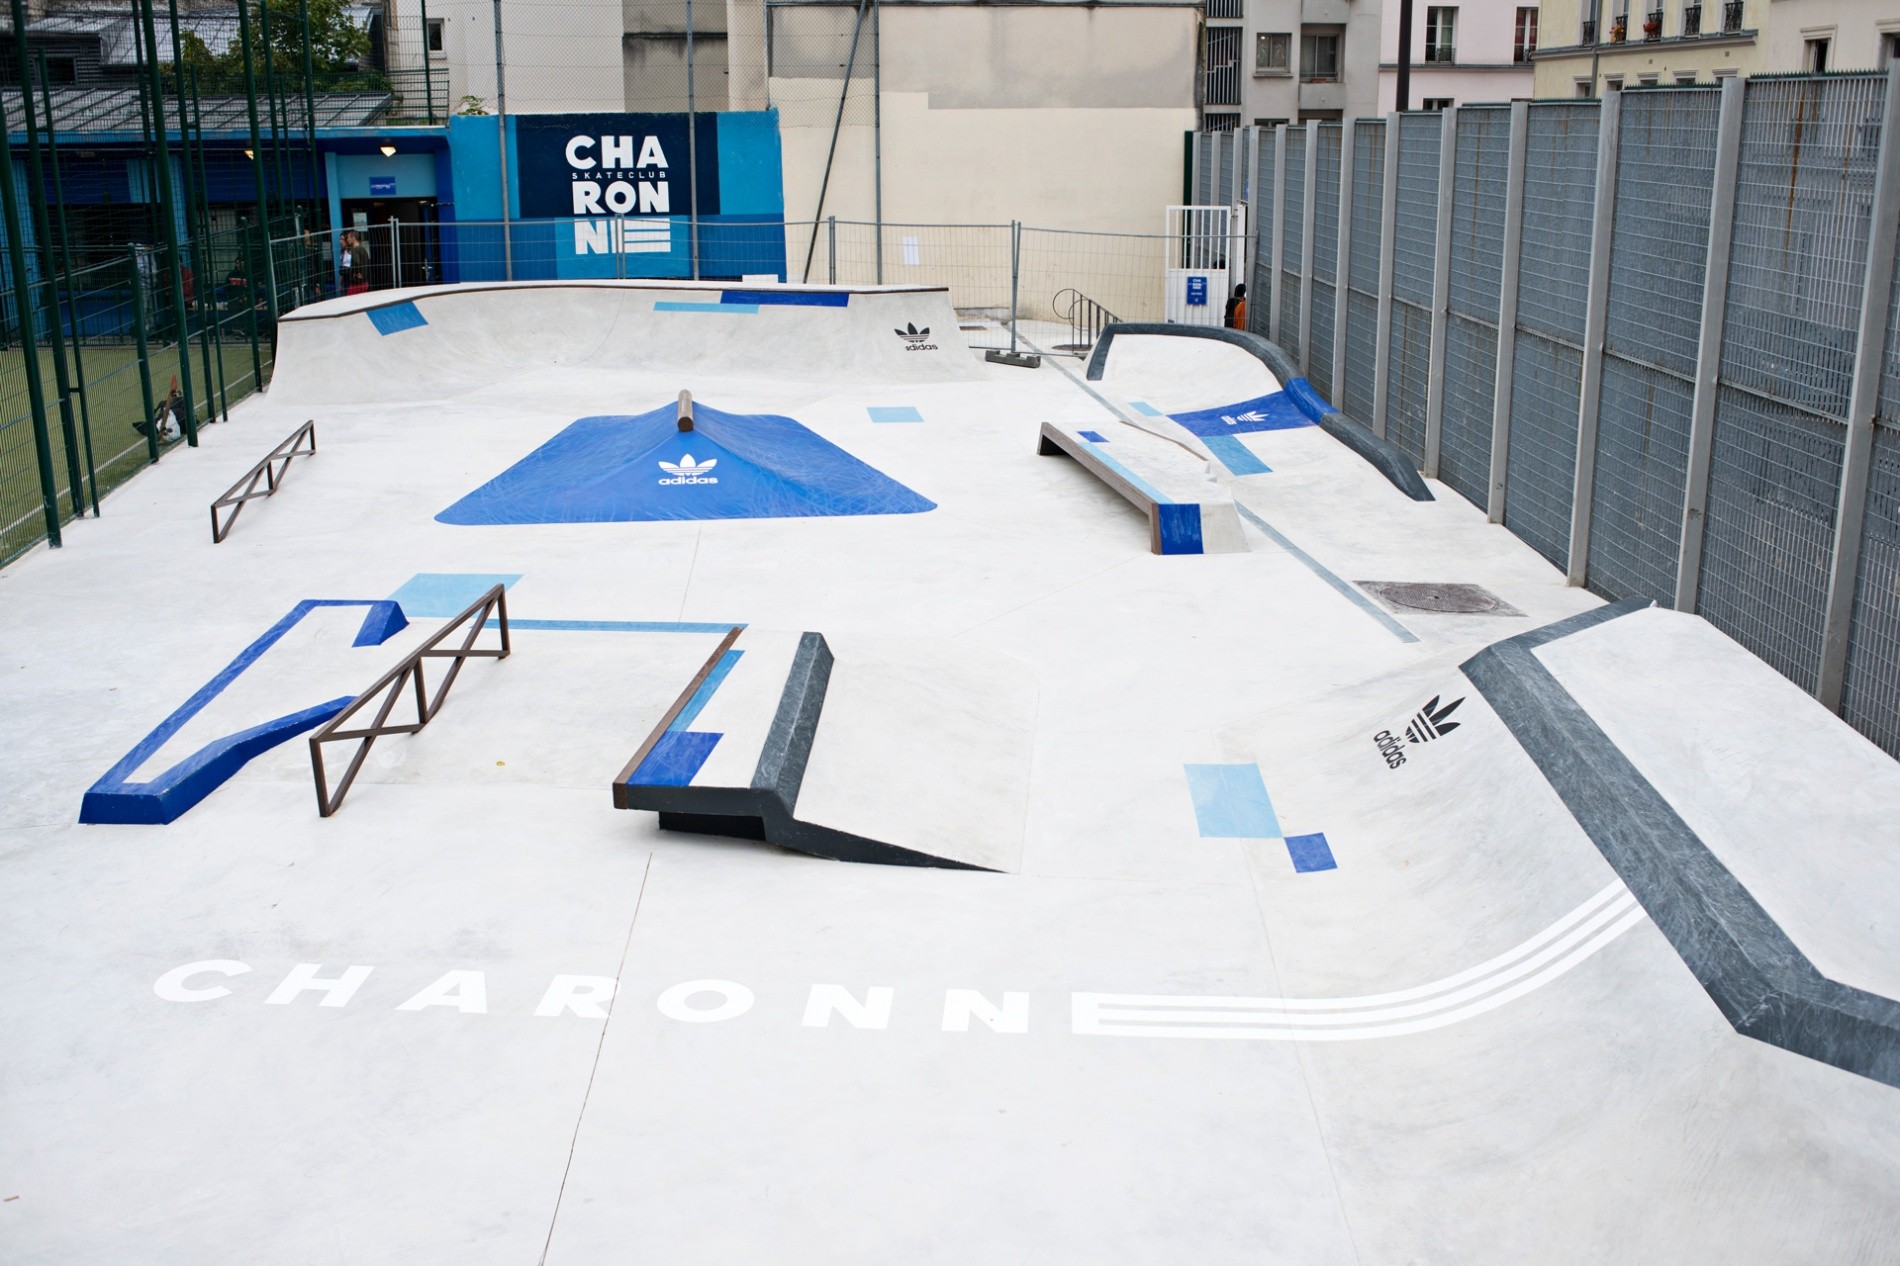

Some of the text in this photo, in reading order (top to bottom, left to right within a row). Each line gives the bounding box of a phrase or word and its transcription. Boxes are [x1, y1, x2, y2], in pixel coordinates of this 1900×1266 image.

[565, 135, 669, 170] CHA
[572, 171, 666, 179] SKATECLUB
[572, 180, 670, 215] RON
[905, 343, 939, 351] adidas
[658, 476, 719, 486] adidas
[1373, 730, 1407, 770] adidas
